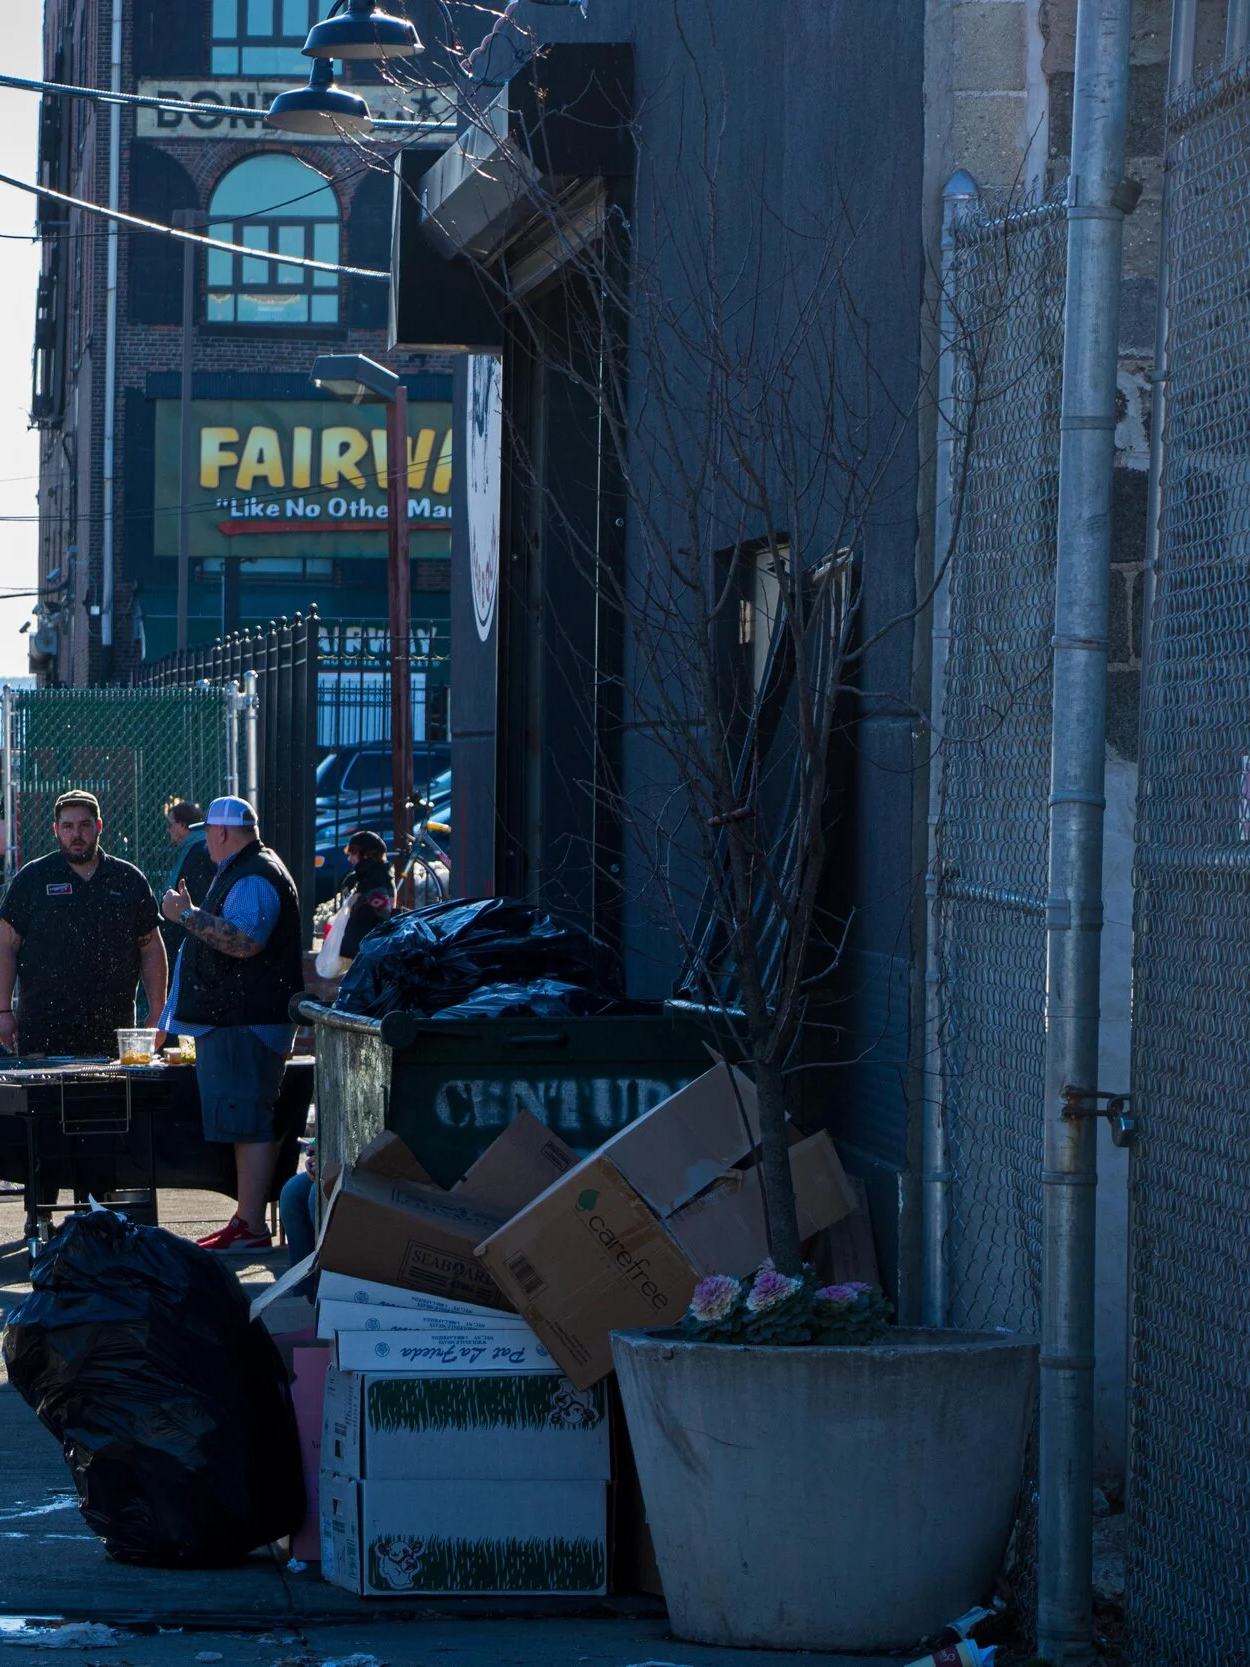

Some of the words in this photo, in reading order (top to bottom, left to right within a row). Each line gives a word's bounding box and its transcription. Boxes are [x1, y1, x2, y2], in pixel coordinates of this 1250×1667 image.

[286, 496, 321, 518] No
[328, 496, 390, 519] Othe
[588, 1215, 669, 1310] carefree
[491, 1346, 526, 1364] Pat
